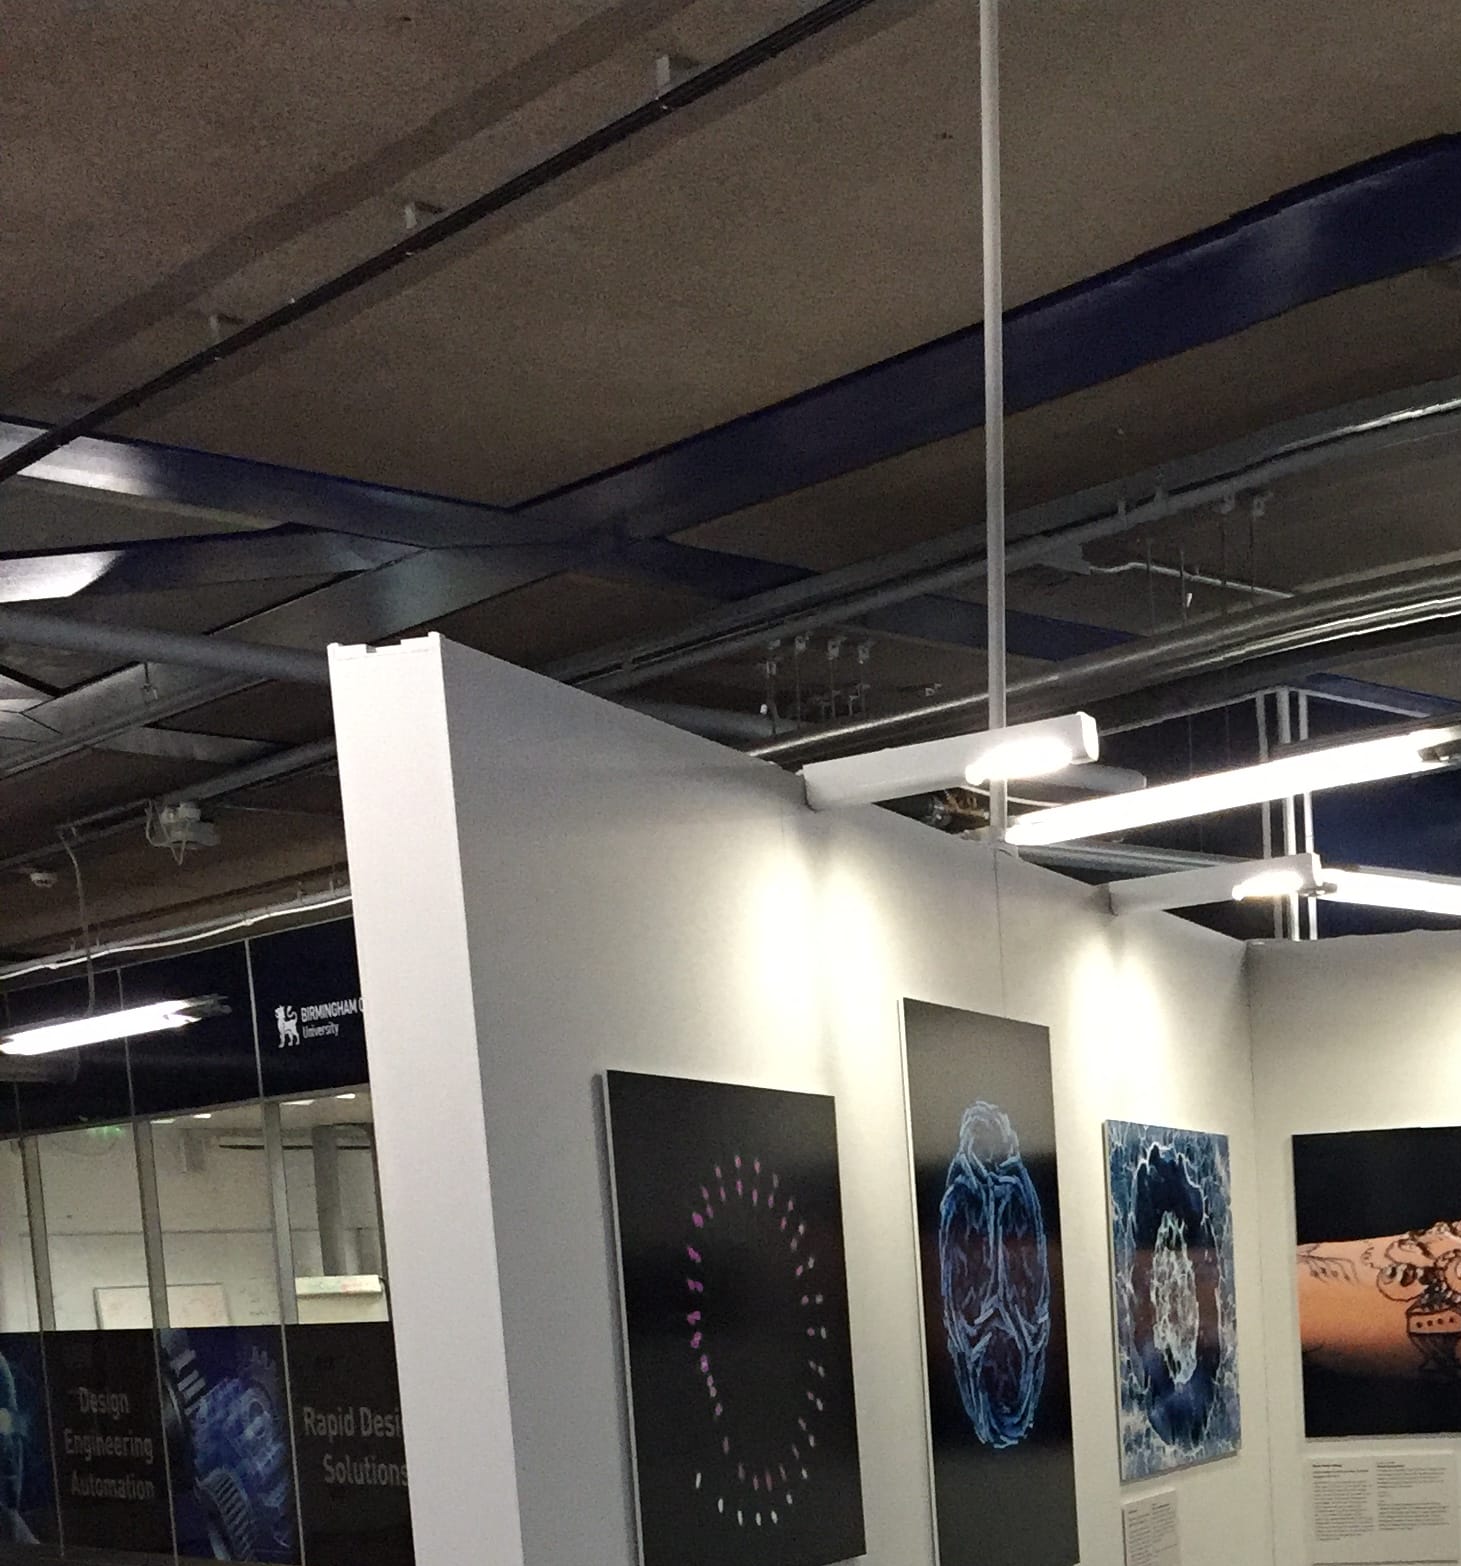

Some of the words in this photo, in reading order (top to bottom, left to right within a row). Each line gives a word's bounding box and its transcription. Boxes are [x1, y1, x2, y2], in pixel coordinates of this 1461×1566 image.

[301, 998, 358, 1022] BIRMINGHAM
[302, 1021, 340, 1039] University
[80, 1386, 130, 1420] Design
[303, 1406, 355, 1443] Rapid
[360, 1406, 402, 1437] Desi
[64, 1427, 154, 1464] Engineering
[71, 1469, 155, 1500] Automation
[322, 1453, 409, 1486] Solutions
